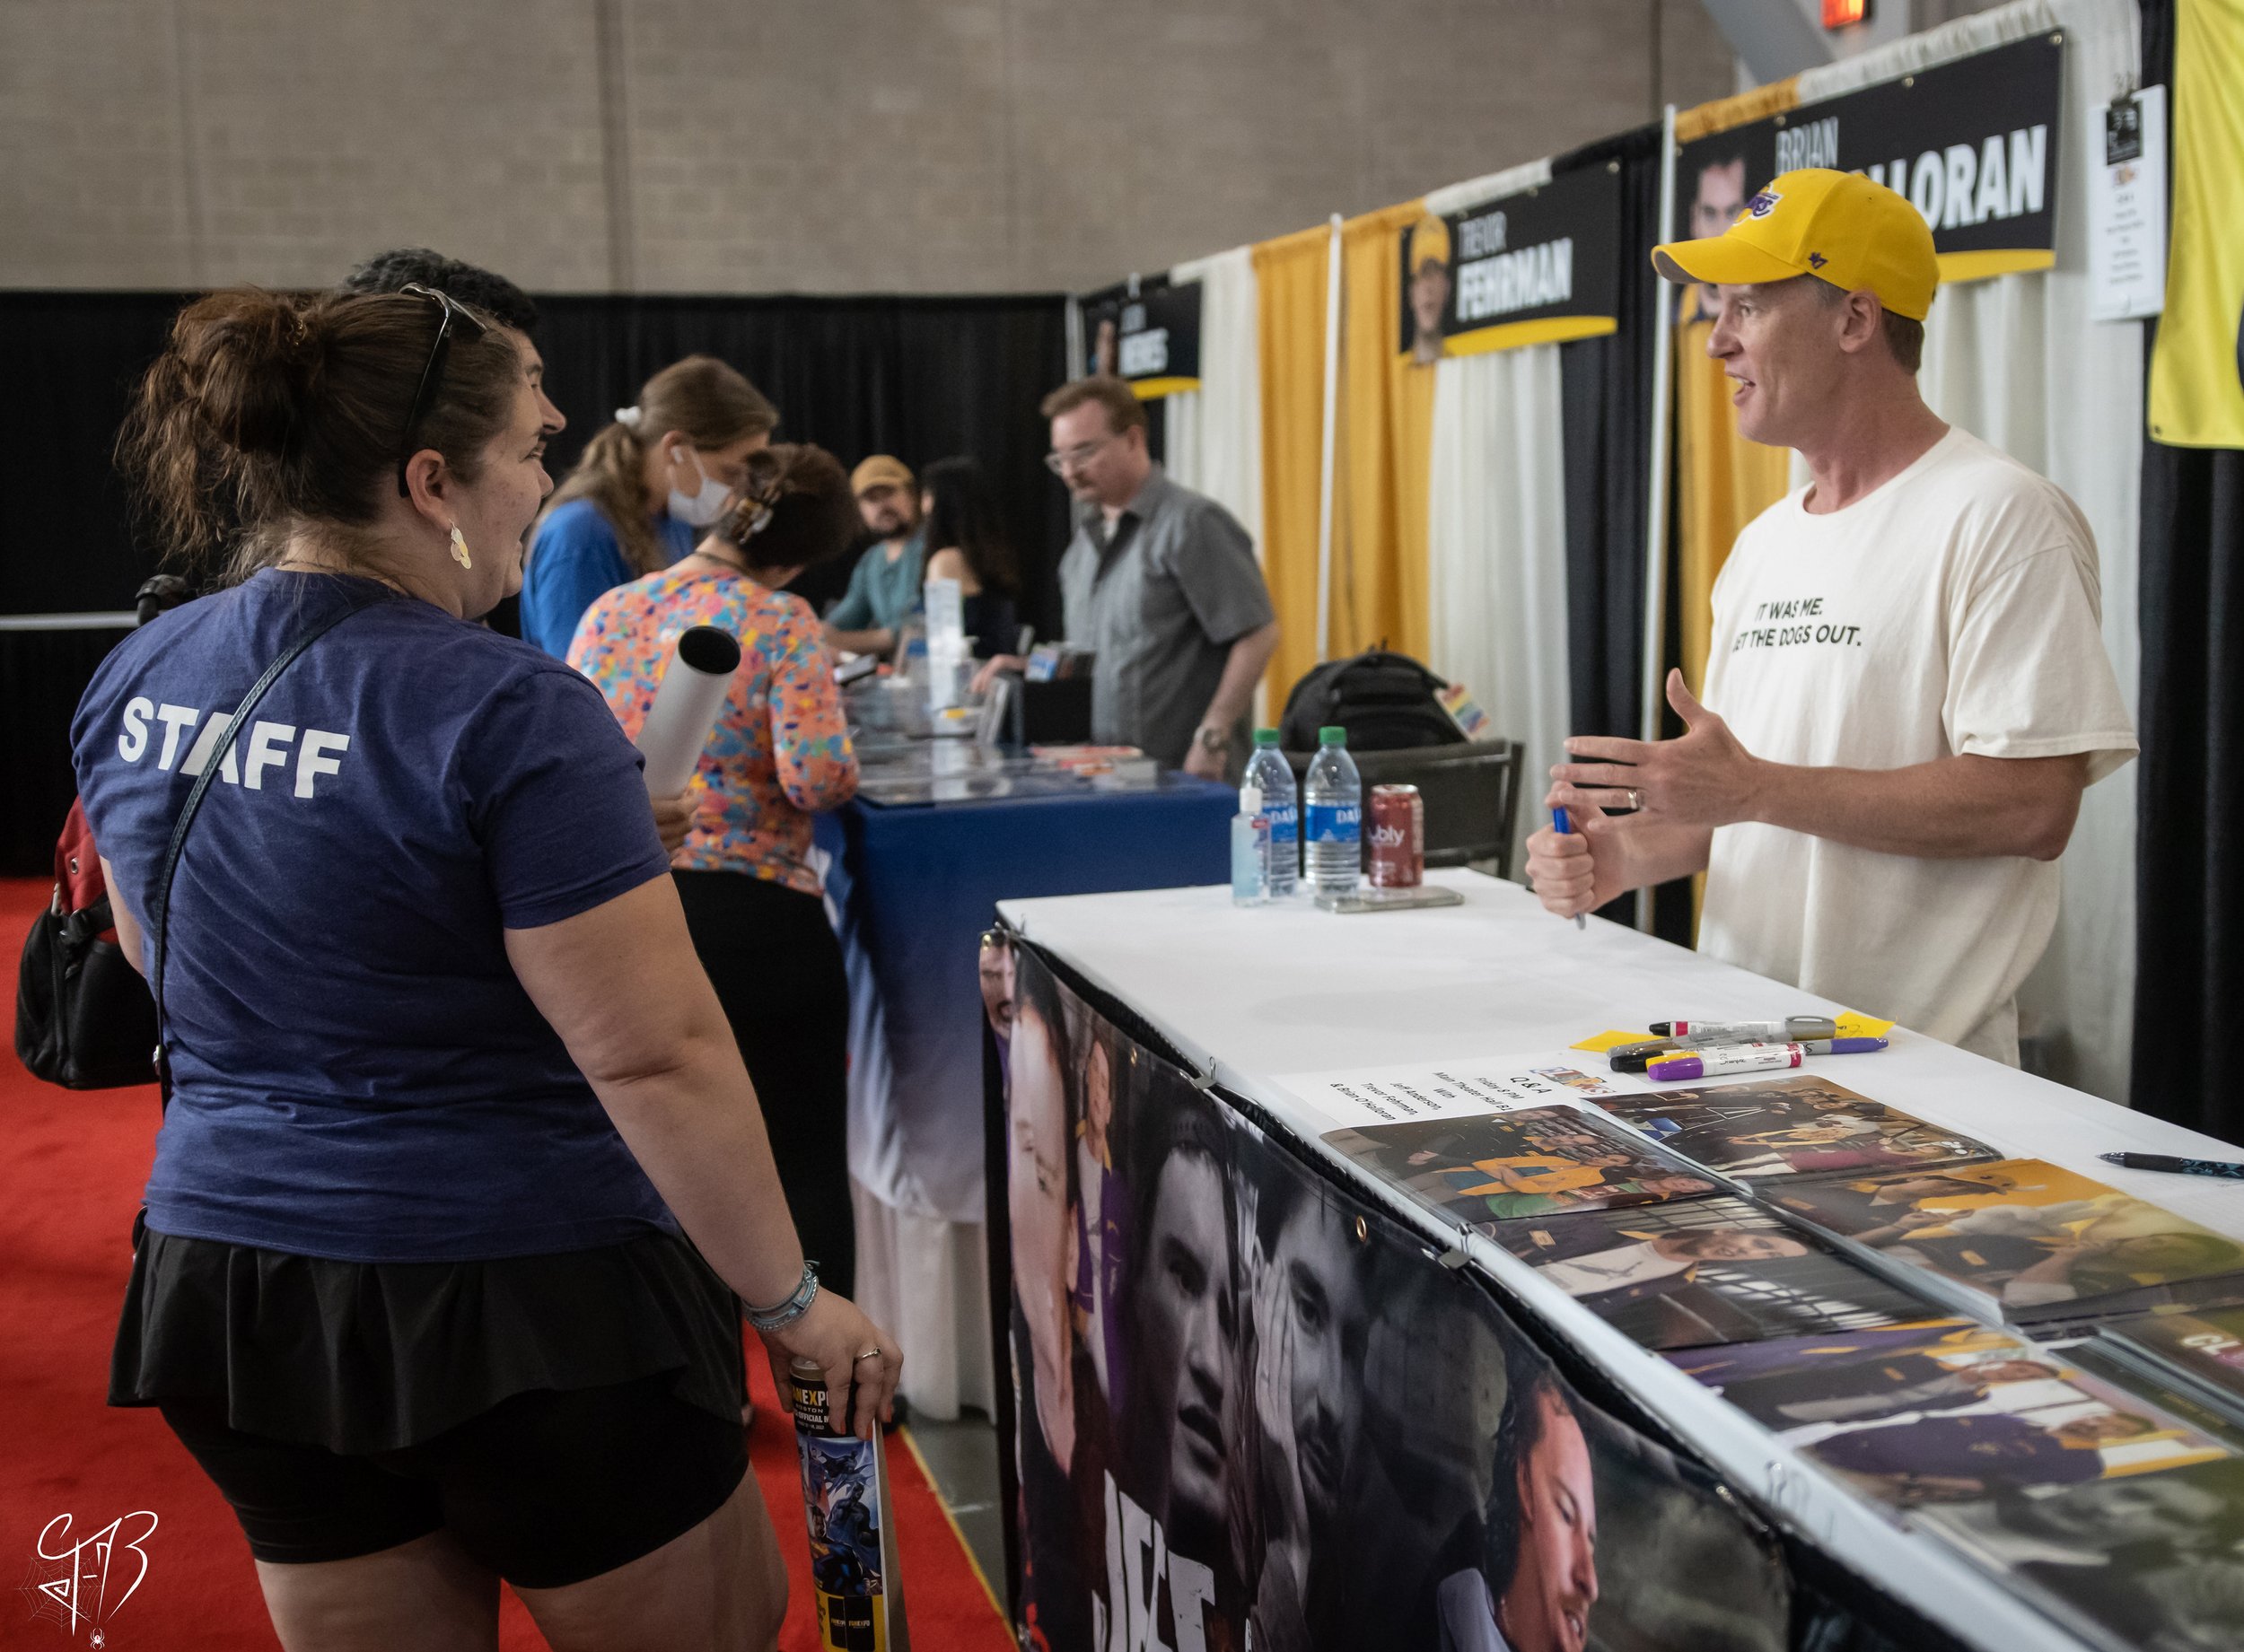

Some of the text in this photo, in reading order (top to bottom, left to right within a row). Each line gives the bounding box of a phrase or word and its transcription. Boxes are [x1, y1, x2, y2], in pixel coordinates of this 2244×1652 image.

[1775, 116, 1838, 178] BRIAN
[1456, 237, 1573, 322] FEHRMAN
[1769, 600, 1799, 619] WAS
[1800, 597, 1823, 616] ME.
[1750, 628, 1776, 647] THE
[1778, 625, 1812, 646] DOGS
[1816, 624, 1861, 646] OUT.
[118, 696, 350, 799] STAFF
[1451, 1081, 1485, 1097] Theater
[1474, 1077, 1502, 1089] Friday
